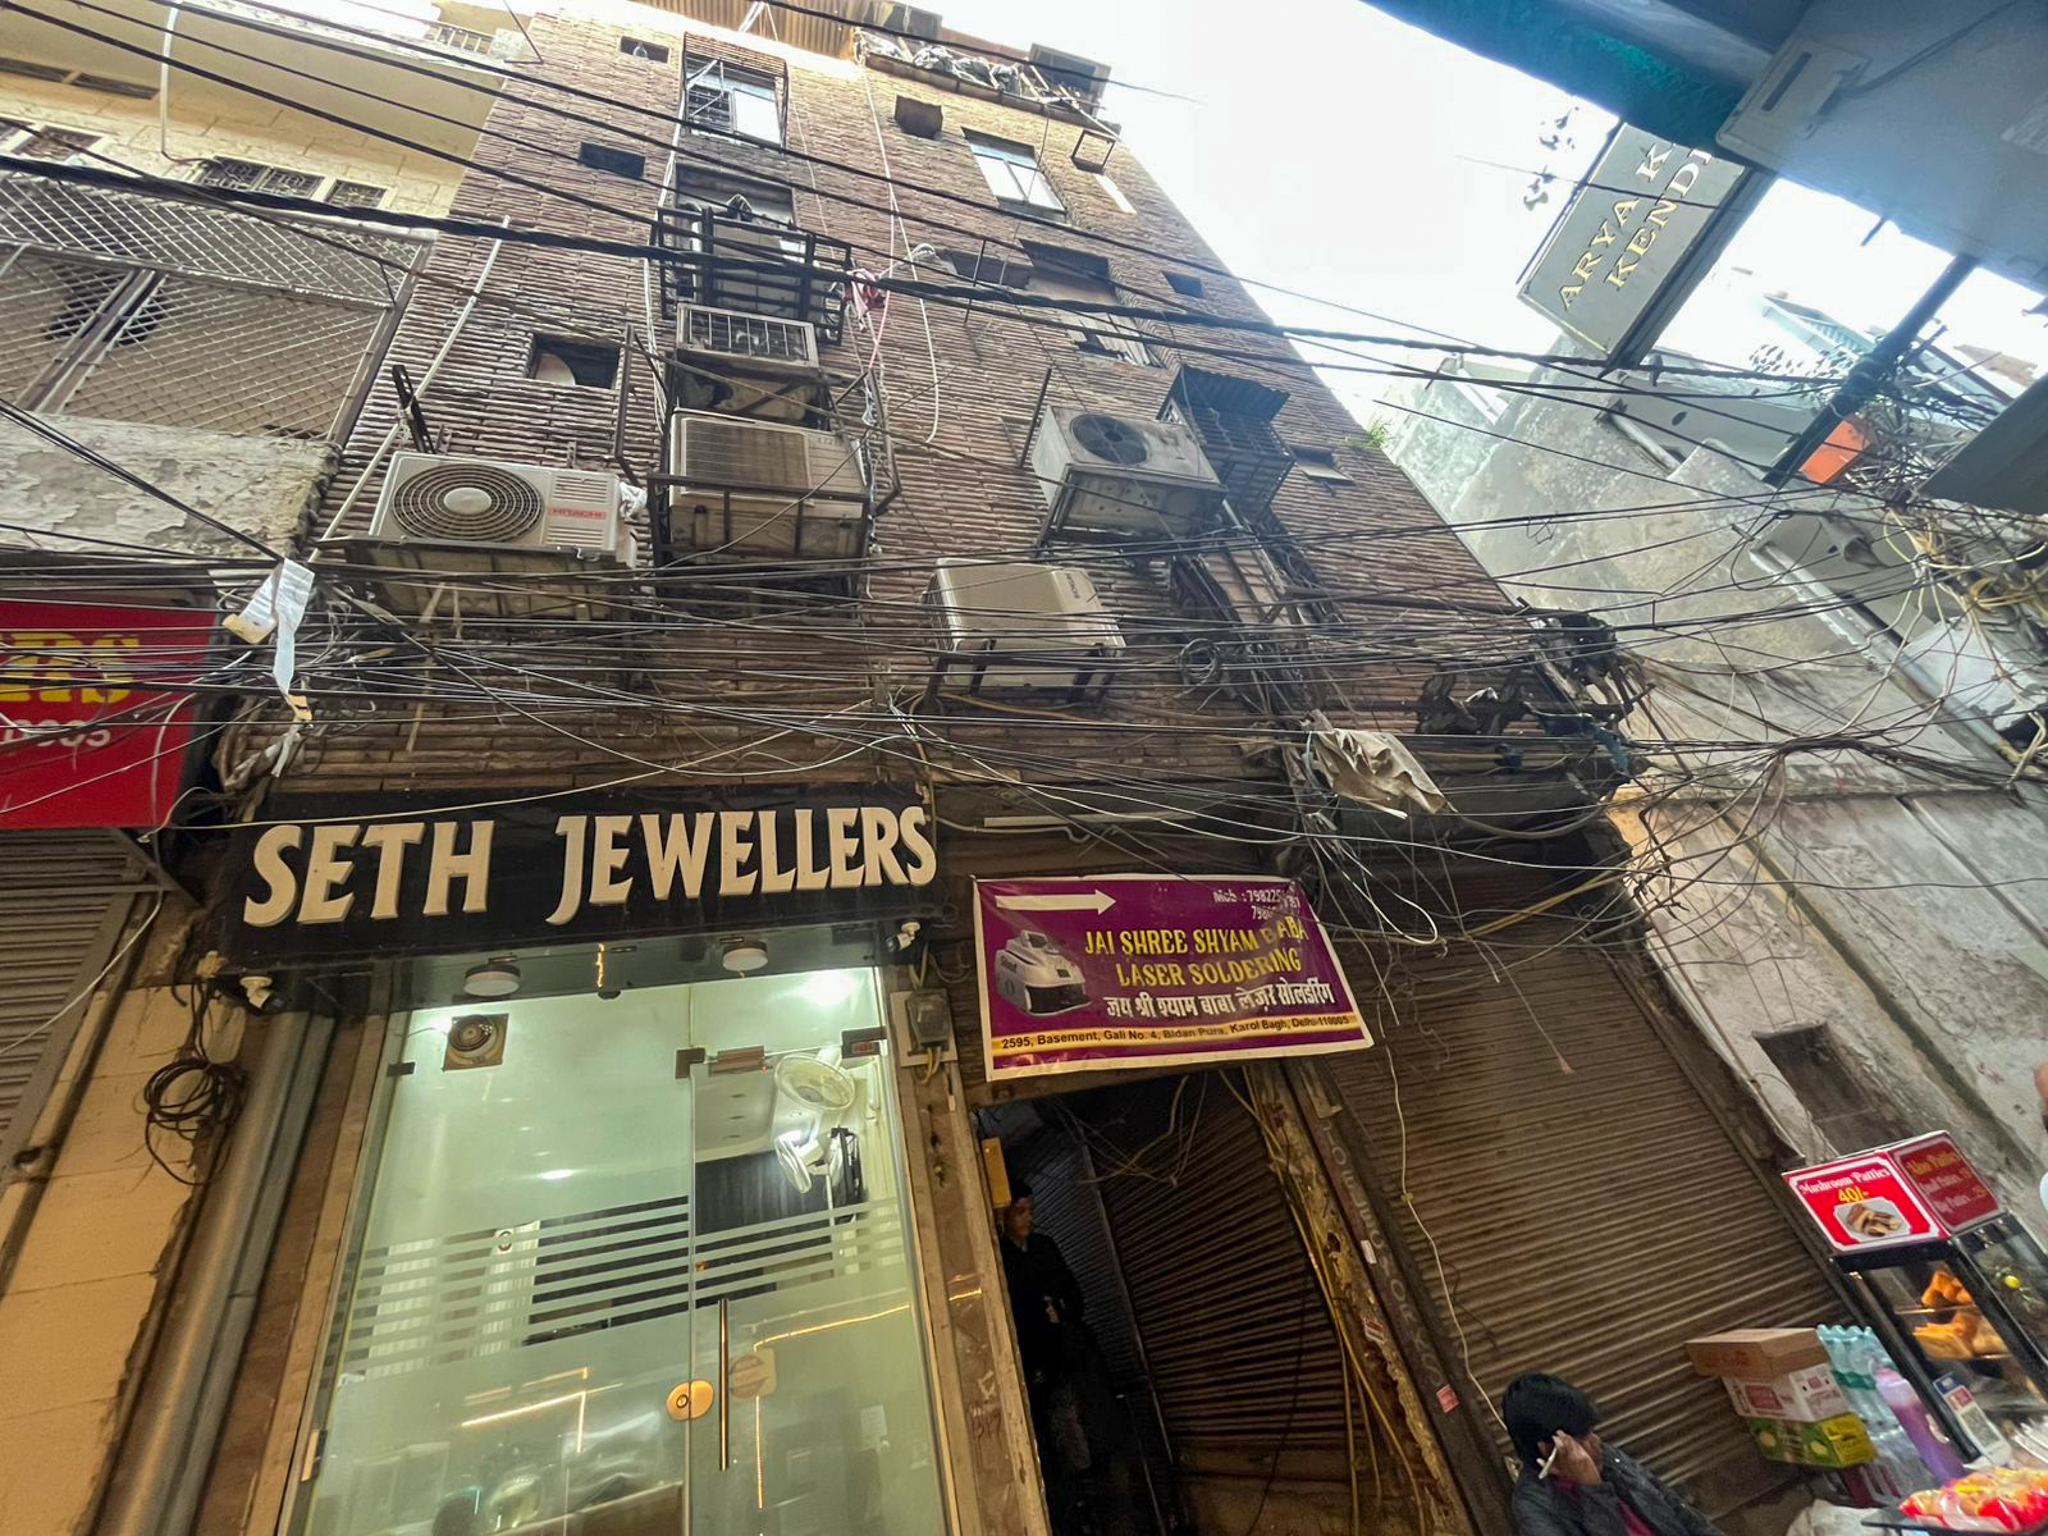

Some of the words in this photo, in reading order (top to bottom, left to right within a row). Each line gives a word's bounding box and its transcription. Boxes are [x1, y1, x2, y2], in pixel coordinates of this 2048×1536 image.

[1559, 197, 1640, 310] ARYA
[1636, 143, 1678, 183] K
[243, 819, 495, 928] SETH
[545, 806, 938, 925] JEWELLERS
[1085, 930, 1115, 955] JAI
[1120, 929, 1188, 955] SHREE
[1193, 929, 1260, 954] SHYAM
[1116, 963, 1187, 987] LASER
[1188, 947, 1301, 985] SOLDERING
[1103, 996, 1133, 1018] जय
[1134, 991, 1157, 1018] श्री
[1155, 996, 1198, 1017] श्याम
[1198, 994, 1236, 1015] बाबा
[1002, 1037, 1034, 1049] 2595,
[1037, 1031, 1101, 1045] Basement,
[1104, 1029, 1126, 1040] Gali
[1128, 1030, 1147, 1040] No.
[1229, 1019, 1260, 1034] Karol
